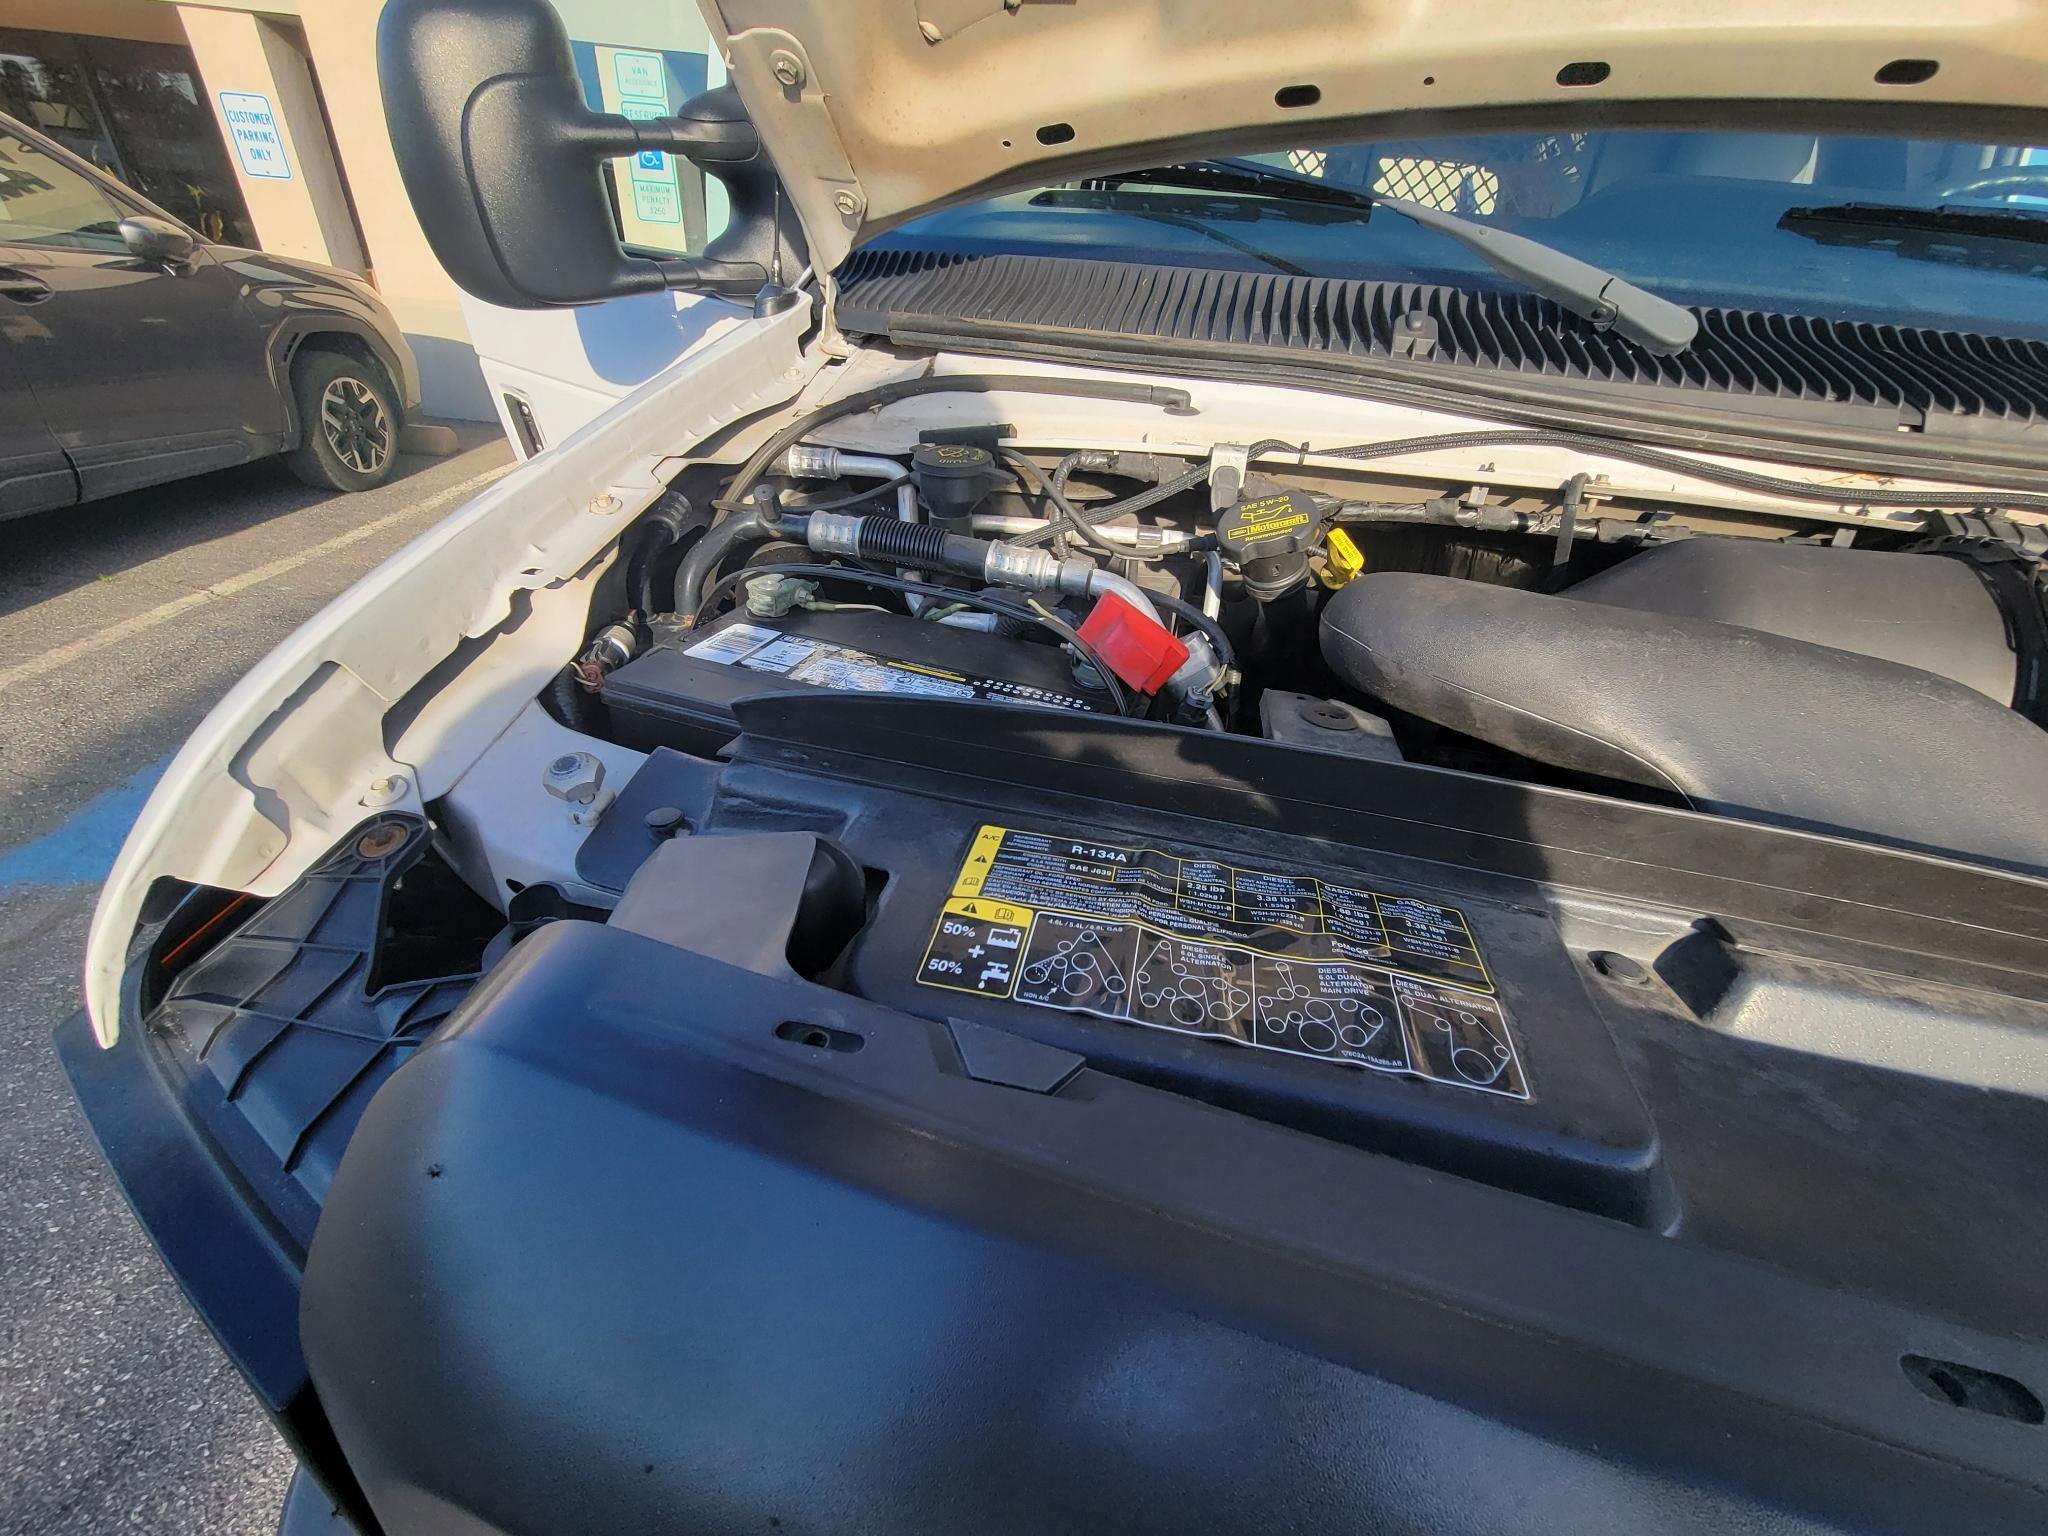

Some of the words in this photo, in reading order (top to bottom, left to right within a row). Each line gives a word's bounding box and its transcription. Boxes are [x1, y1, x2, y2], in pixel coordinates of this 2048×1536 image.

[228, 110, 272, 126] CUSTOMER
[236, 129, 275, 143] PARKING
[249, 147, 272, 161] ONLY
[1240, 503, 1257, 511] SAE
[1259, 496, 1290, 508] 5W-20
[1250, 514, 1305, 534] Motorcraft
[981, 833, 1000, 842] A/C
[1071, 845, 1128, 863] R-134A
[1069, 863, 1089, 872] SAE
[1091, 867, 1112, 876] J639
[1263, 875, 1295, 884] DIESEL
[1187, 882, 1208, 891] 2.25
[1209, 885, 1226, 893] lbs
[1324, 885, 1370, 899] GASOLINE
[1396, 900, 1442, 914] GASOLINE
[1148, 910, 1189, 923] PERSONNEL
[943, 921, 976, 938] 50%
[1169, 920, 1205, 931] PERSONAL
[1206, 925, 1248, 938] CALIFICADO
[1181, 944, 1209, 954] DIESEL
[1331, 940, 1369, 955] FoMoCo
[1180, 950, 1196, 958] 6.0L
[1197, 953, 1227, 963] SINGLE
[1180, 956, 1232, 971] ALTERNATOR
[928, 958, 963, 975] 50%
[1318, 967, 1348, 975] DIESEL
[1337, 974, 1361, 982] DUAL
[1319, 980, 1375, 991] ALTERNATOR
[1343, 987, 1370, 996] DRIVE
[1395, 979, 1425, 992] DIESEL
[1414, 991, 1438, 1001] DUAL
[1439, 996, 1496, 1013] ALTERNATOR
